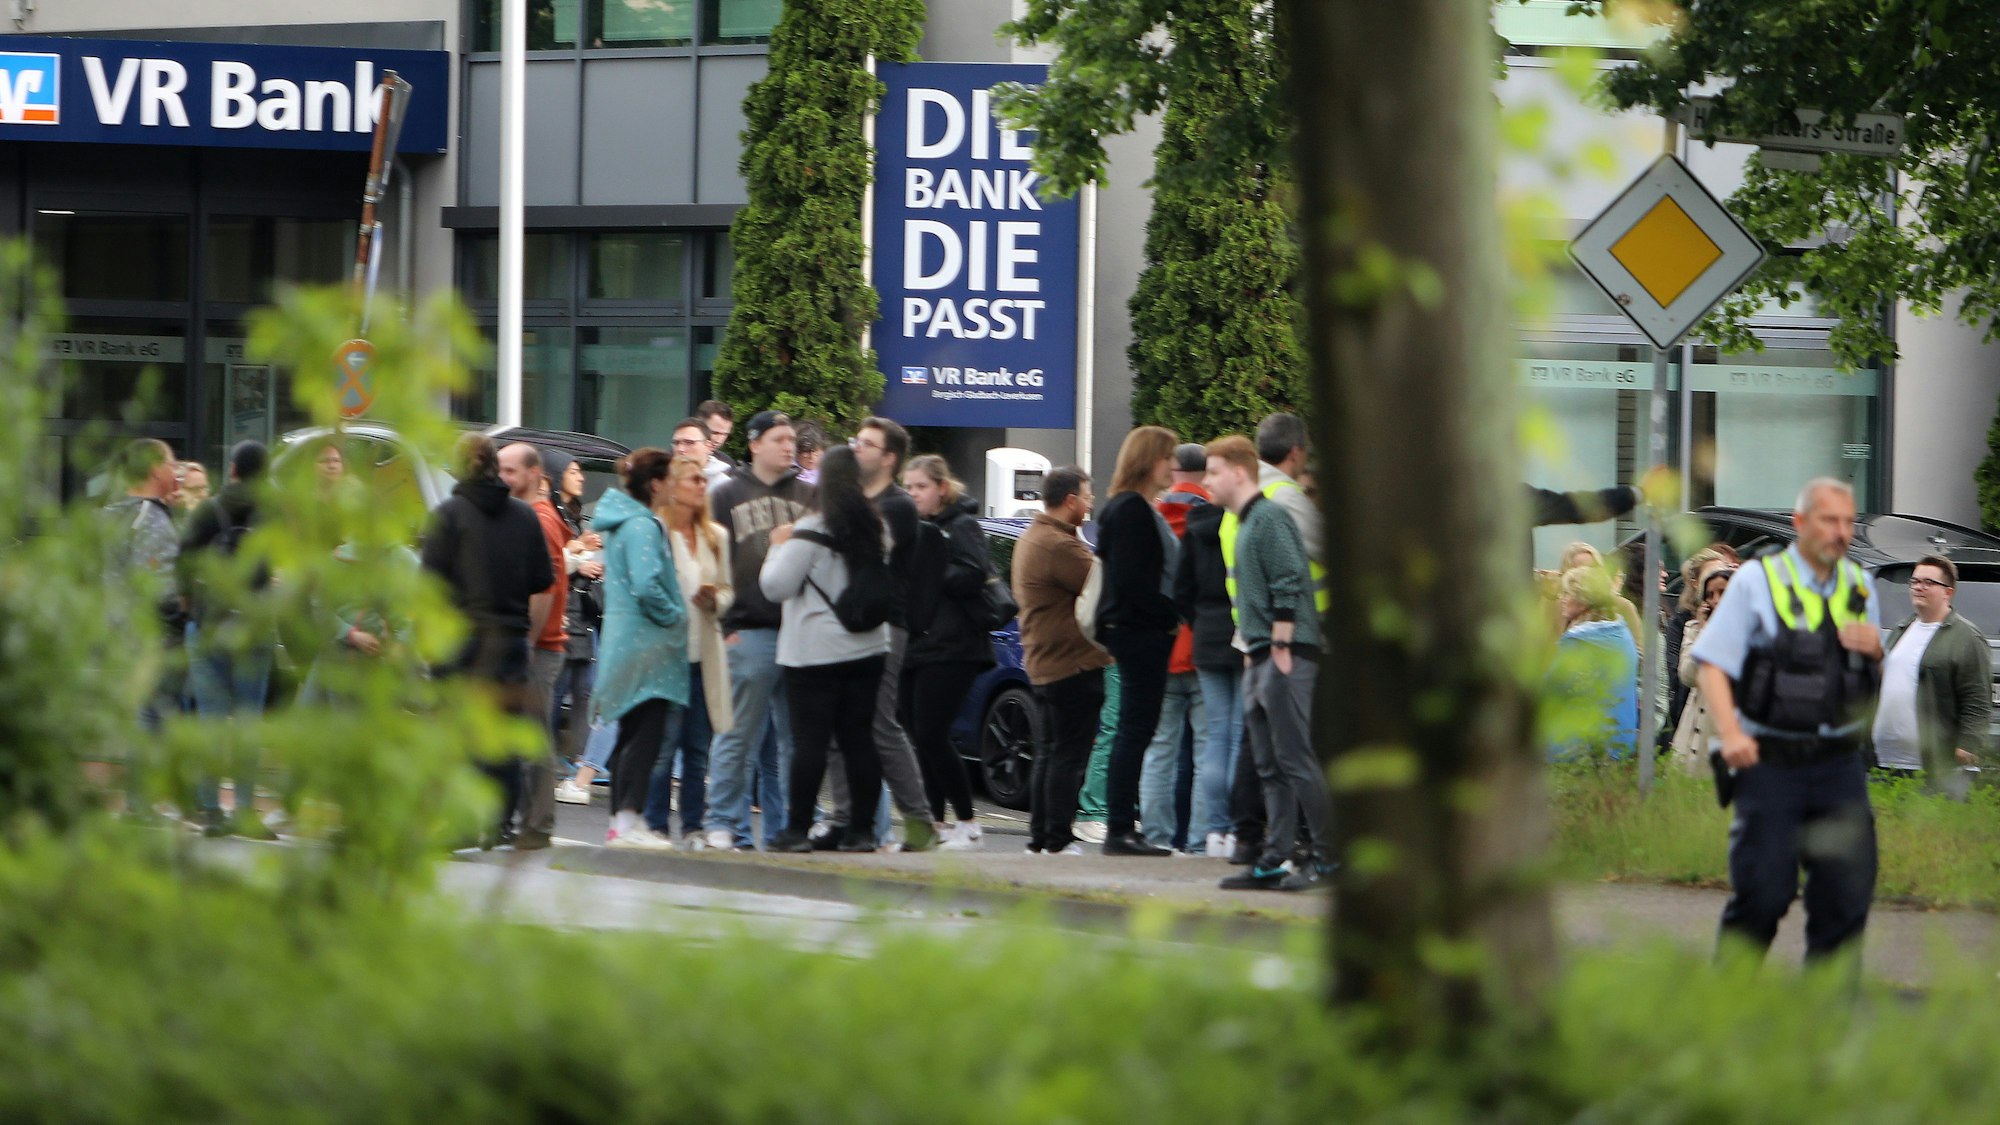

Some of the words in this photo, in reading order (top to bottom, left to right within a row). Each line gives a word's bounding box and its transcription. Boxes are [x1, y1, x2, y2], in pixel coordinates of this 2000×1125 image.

[82, 57, 190, 127] VR
[211, 61, 383, 133] Bank
[905, 168, 1043, 211] BANK
[903, 219, 1041, 292] DIE
[902, 297, 1046, 340] PASST
[98, 340, 136, 355] Bank
[138, 342, 160, 356] eG
[931, 366, 962, 384] VR
[964, 366, 1014, 386] Bank
[1015, 368, 1044, 387] eG
[1551, 366, 1573, 381] VR
[1576, 366, 1613, 382] Bank
[1616, 368, 1637, 383] eG
